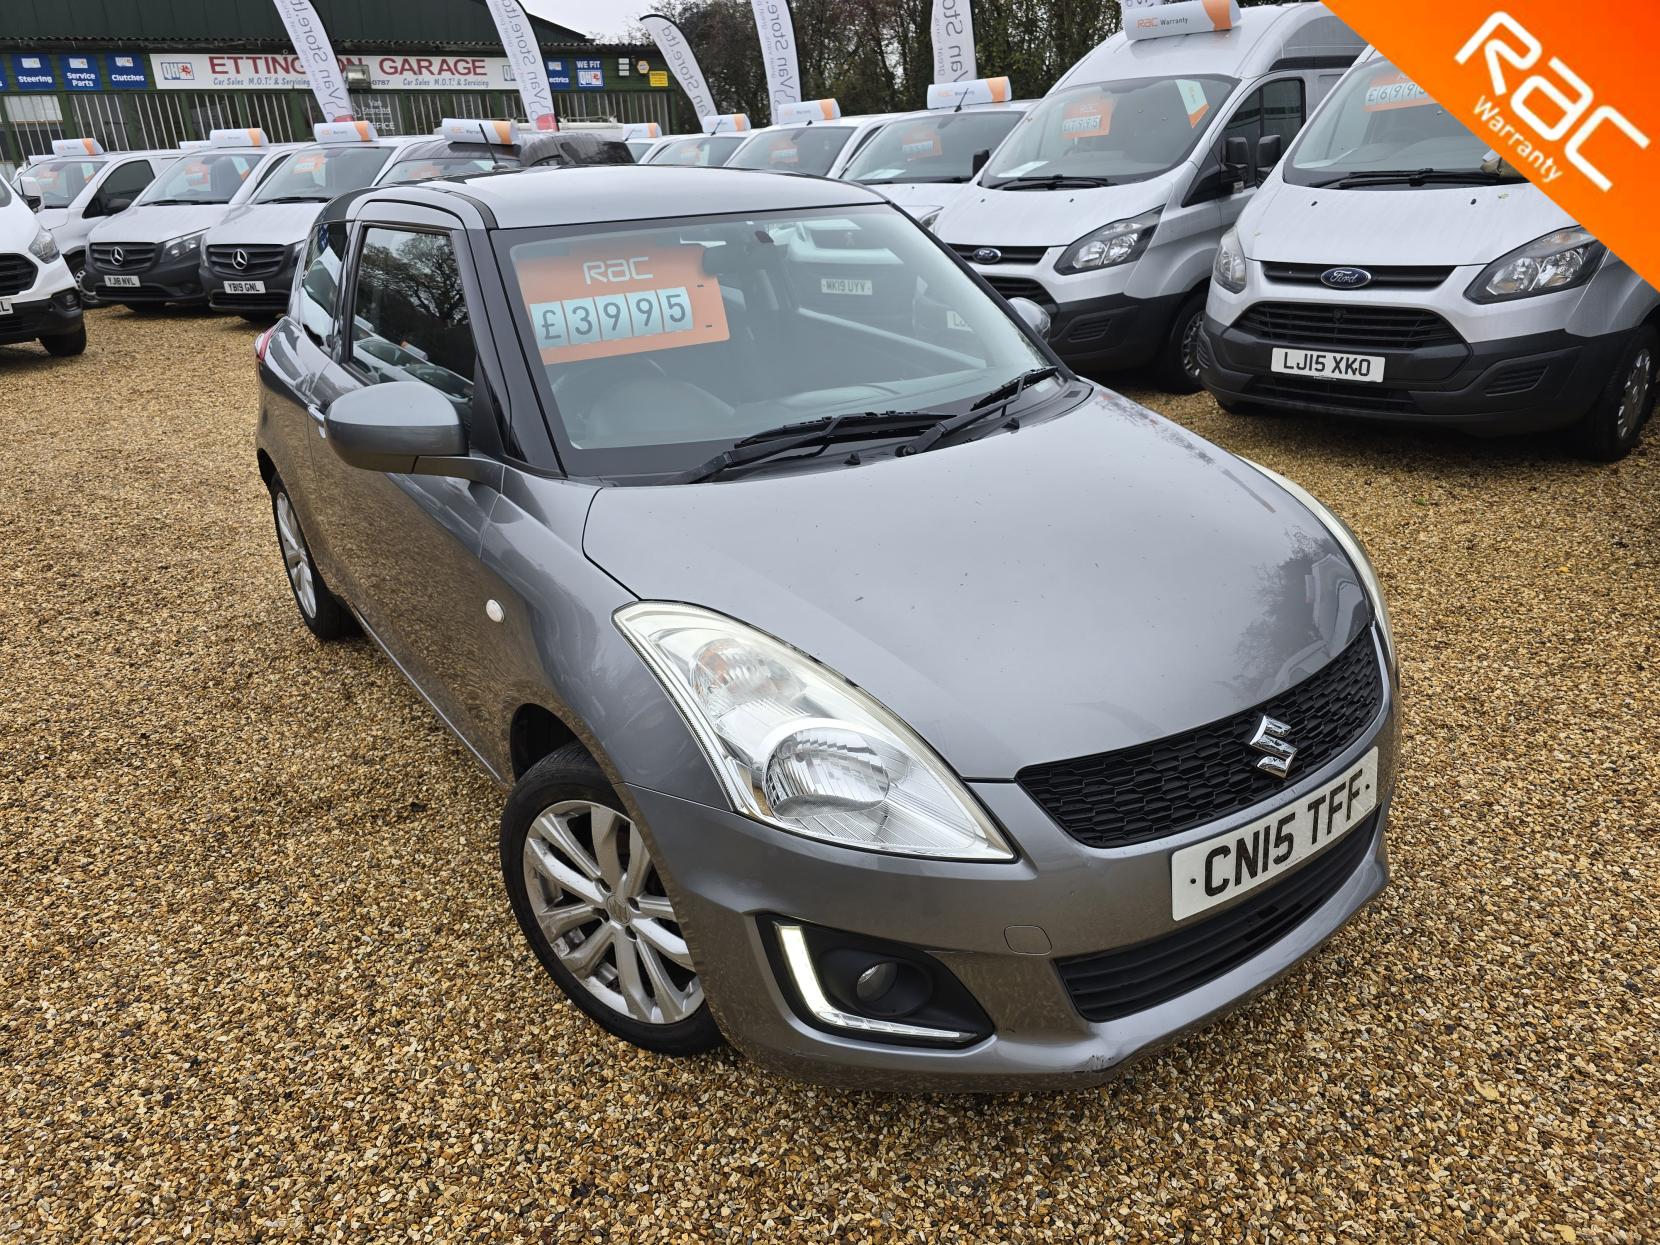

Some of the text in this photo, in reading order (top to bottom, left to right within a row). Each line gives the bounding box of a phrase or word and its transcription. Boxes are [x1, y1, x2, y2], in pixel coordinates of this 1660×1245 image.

[1160, 17, 1189, 26] Warranty
[378, 57, 488, 77] GARAGE
[576, 60, 601, 69] WE FIT
[18, 75, 53, 84] Steering
[66, 72, 96, 80] Service
[111, 74, 145, 82] Clutches
[549, 76, 569, 84] ectrics
[213, 77, 225, 86] Car
[226, 77, 244, 86] Sales
[273, 77, 279, 86] &
[402, 78, 412, 86] Car
[414, 78, 430, 86] Sales
[463, 79, 489, 88] Servicing
[107, 276, 137, 287] YJ18 NVL
[1330, 270, 1359, 283] Ford
[228, 282, 261, 293] YB19 GNL
[541, 293, 686, 340] £3995
[1283, 351, 1371, 377] LJ15 XKO
[1204, 768, 1364, 897] CN15 TFF
